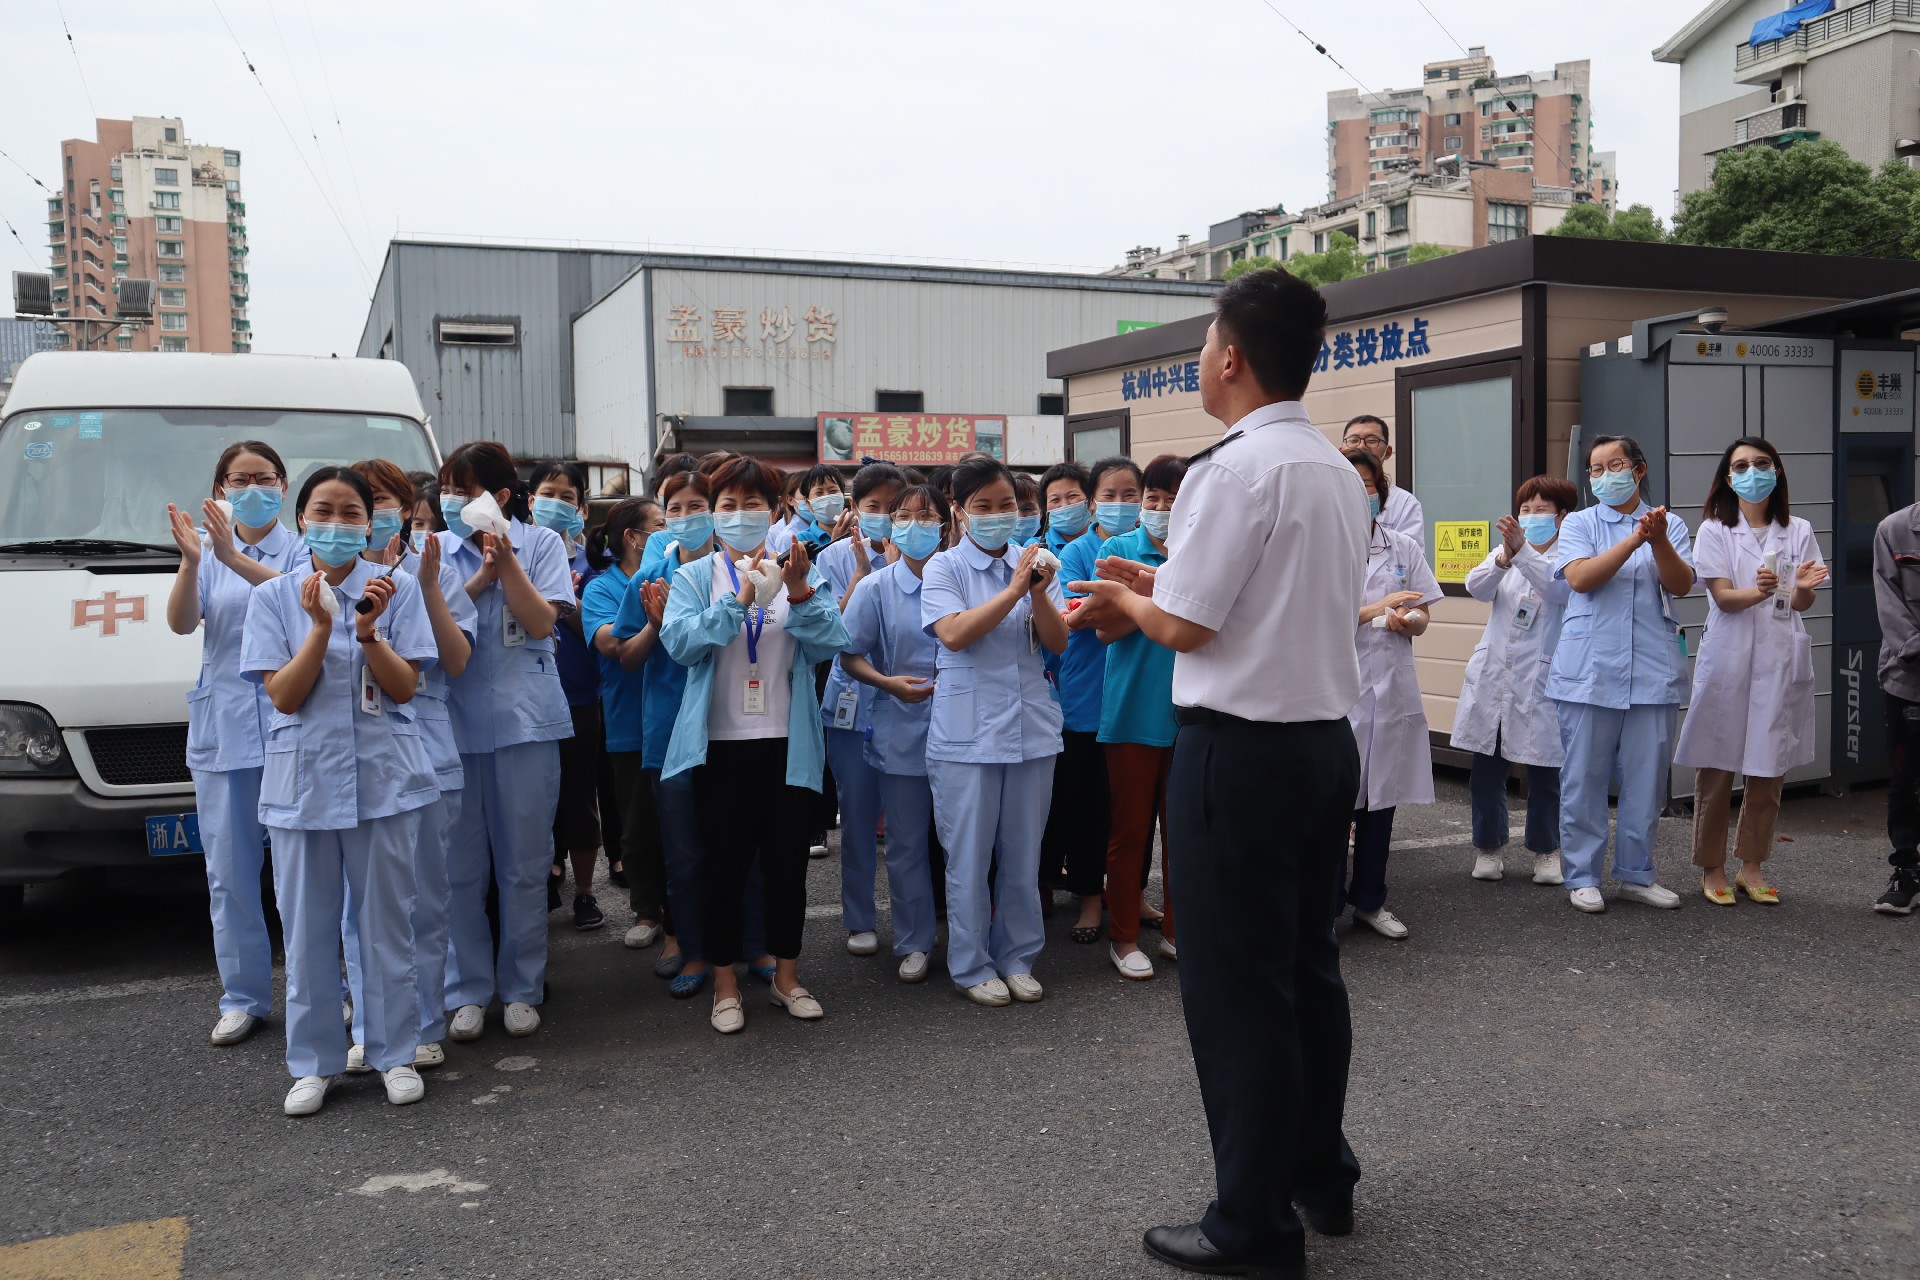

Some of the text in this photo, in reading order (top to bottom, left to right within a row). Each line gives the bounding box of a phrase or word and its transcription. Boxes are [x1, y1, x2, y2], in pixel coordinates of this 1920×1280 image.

[666, 305, 837, 344] 孟豪炒货
[1750, 344, 1814, 358] 40006 33333
[1121, 361, 1200, 401] 杭州中兴医
[1877, 373, 1902, 391] 丰巢
[1873, 391, 1888, 400] HIVE
[857, 416, 971, 449] 孟豪炒货
